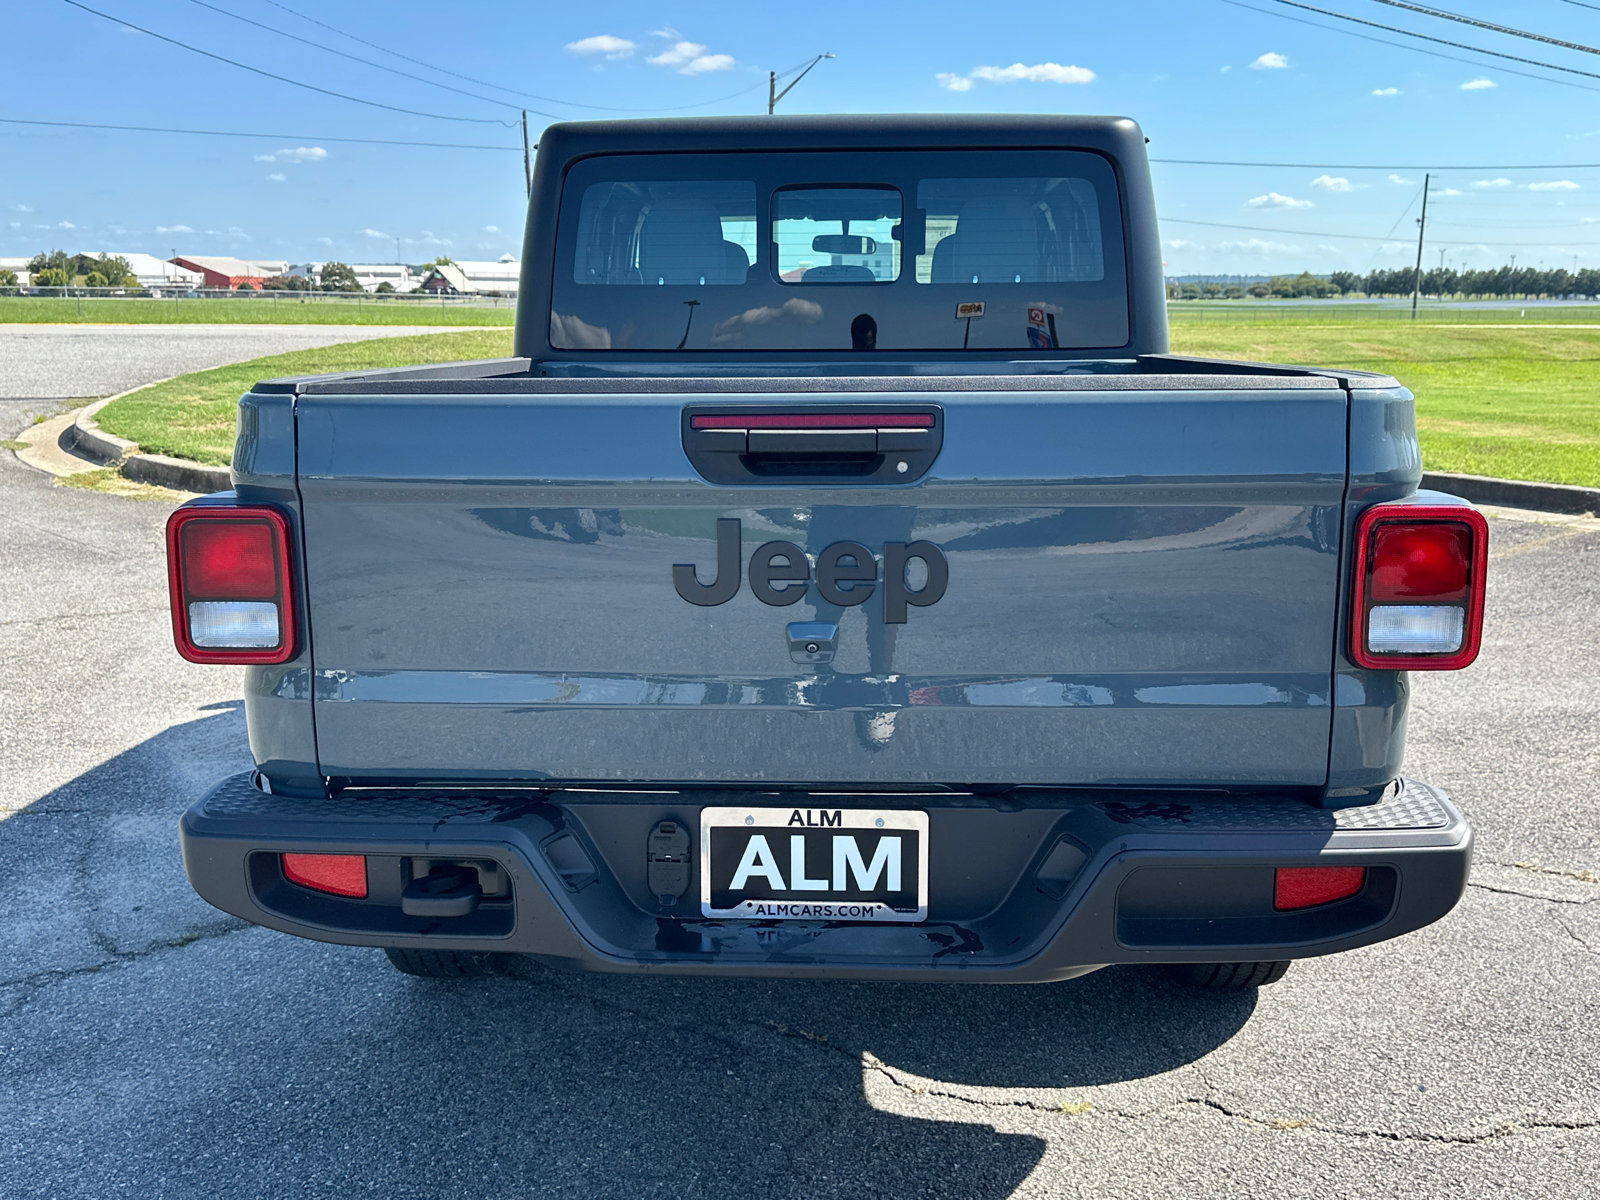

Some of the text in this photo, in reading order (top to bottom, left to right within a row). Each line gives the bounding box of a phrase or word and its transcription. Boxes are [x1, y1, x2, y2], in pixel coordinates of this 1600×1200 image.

[672, 517, 949, 624] Jeep
[787, 809, 842, 827] ALM
[728, 834, 902, 892] ALM
[755, 903, 874, 918] ALMCARS.COM
